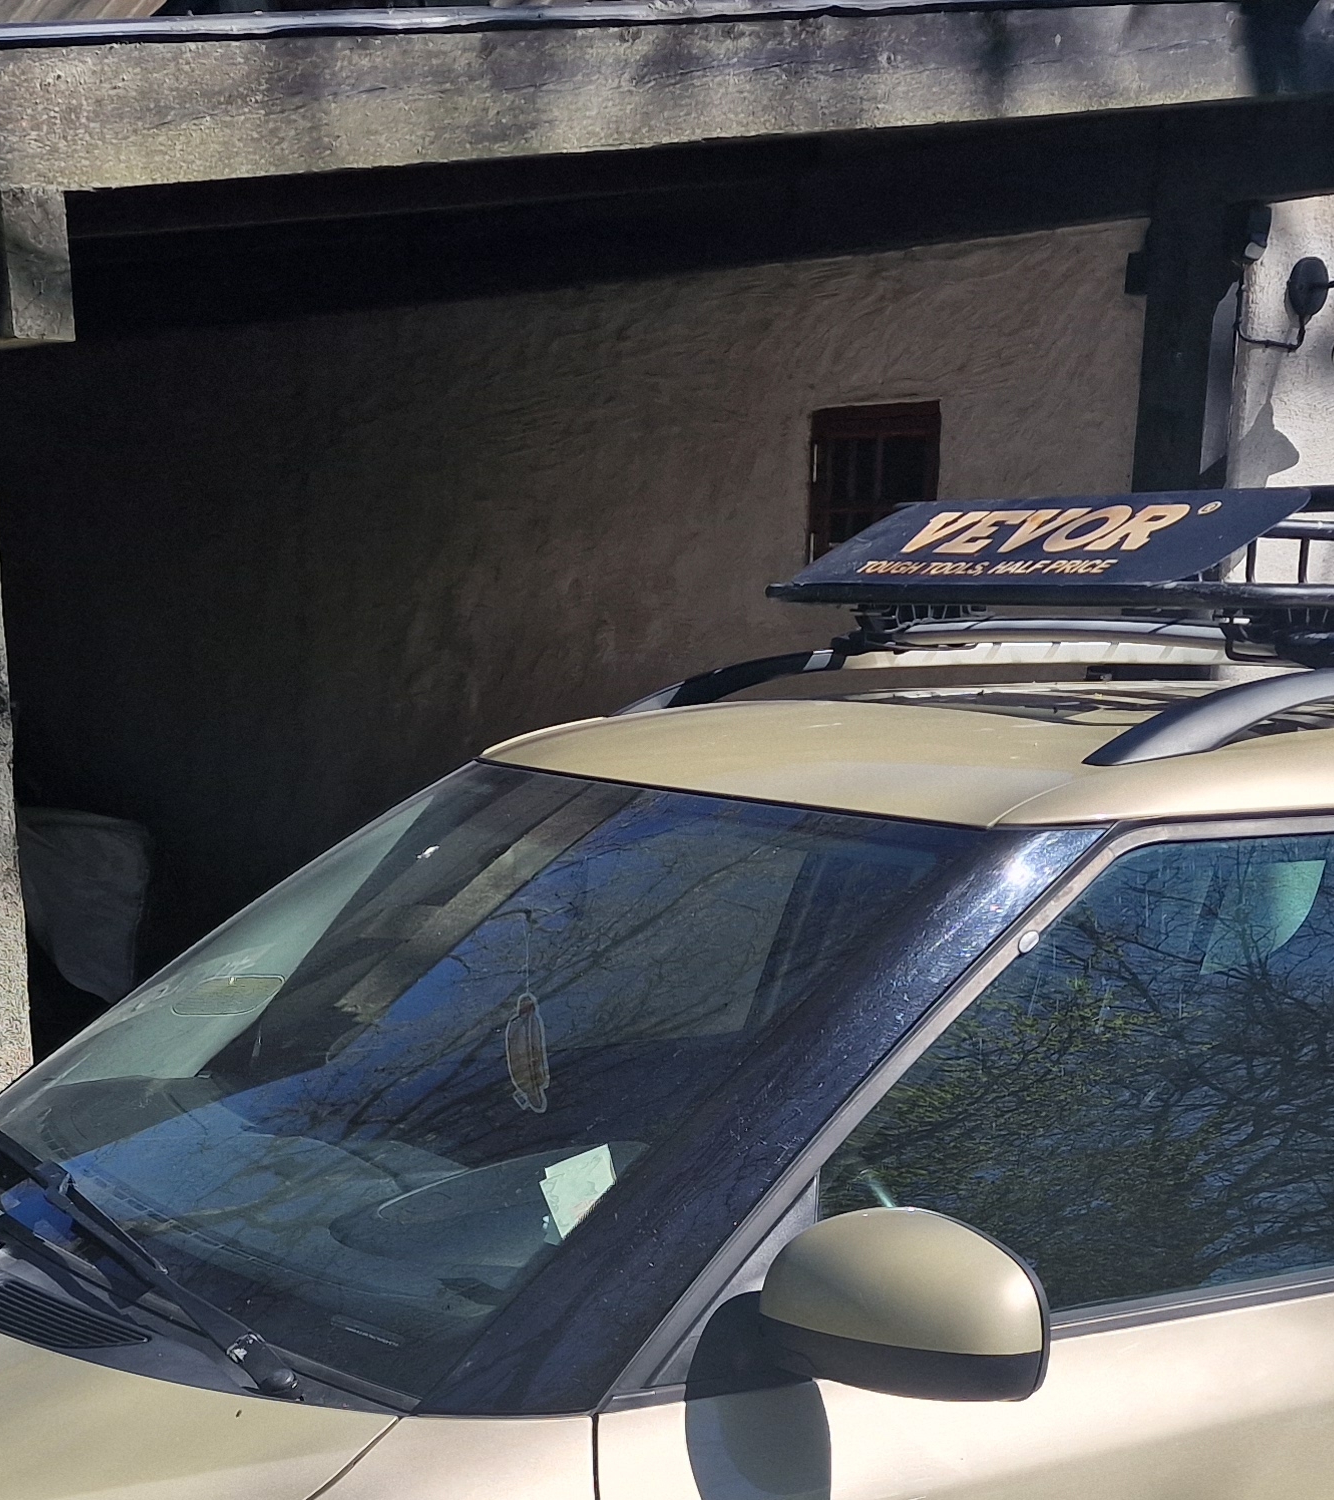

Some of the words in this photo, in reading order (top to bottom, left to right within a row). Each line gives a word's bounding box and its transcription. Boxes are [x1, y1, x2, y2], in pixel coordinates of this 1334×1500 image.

[899, 503, 1192, 554] VEVOR
[856, 560, 927, 575] TOUGH
[921, 561, 990, 577] TOOLS,
[987, 559, 1052, 575] HALF
[1043, 558, 1119, 574] PRICE
